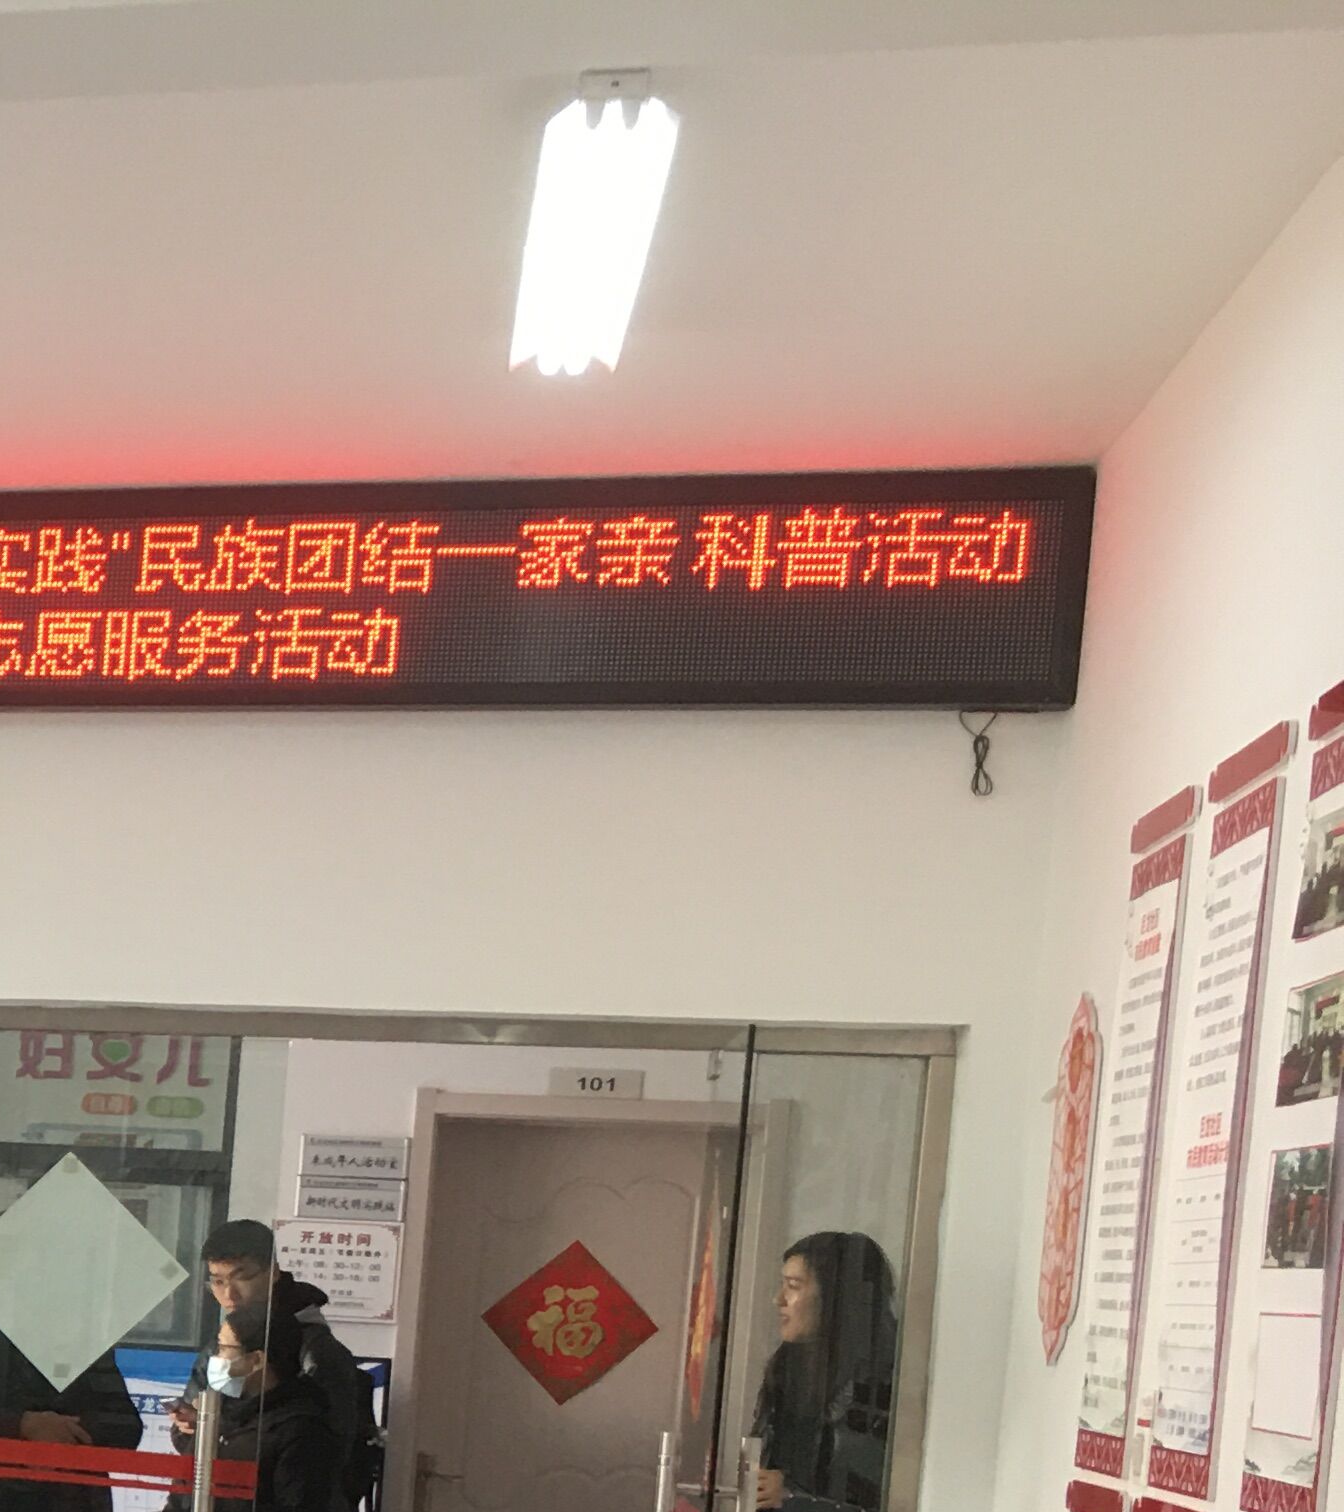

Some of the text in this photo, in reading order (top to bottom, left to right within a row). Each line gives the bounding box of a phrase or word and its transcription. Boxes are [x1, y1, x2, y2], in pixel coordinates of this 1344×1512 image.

[577, 1075, 617, 1092] 101
[300, 1230, 372, 1247] 开放时间
[527, 1285, 605, 1359] 福
